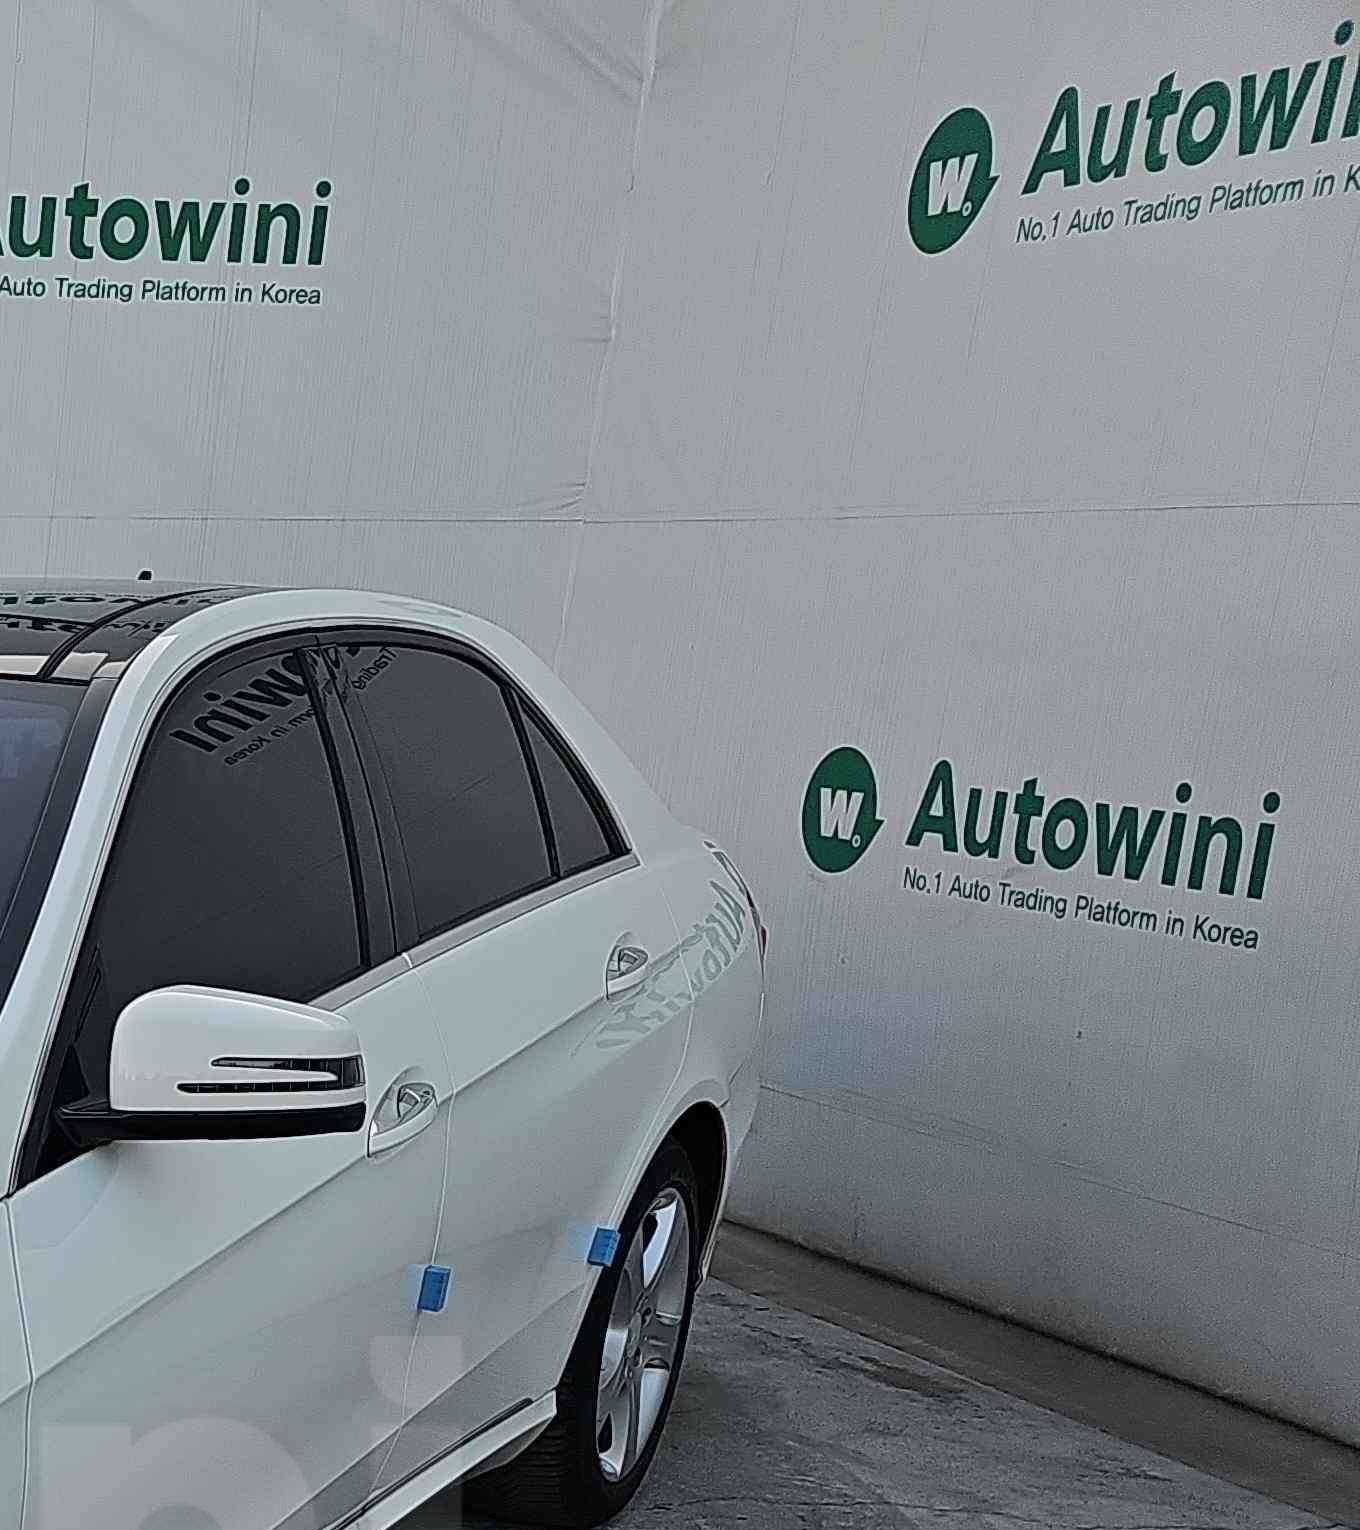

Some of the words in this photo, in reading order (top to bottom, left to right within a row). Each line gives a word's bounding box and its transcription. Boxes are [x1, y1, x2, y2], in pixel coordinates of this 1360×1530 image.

[1016, 211, 1061, 243] No.1
[1065, 207, 1114, 236] Auto
[1124, 194, 1202, 226] Trading
[1208, 178, 1305, 213] Platform
[1312, 169, 1335, 197] in
[54, 277, 133, 303] Trading
[141, 279, 226, 302] Platform
[234, 282, 253, 303] in
[260, 283, 321, 305] Korea
[905, 759, 1281, 900] Autowini
[903, 866, 942, 894] No.1
[948, 875, 991, 903] Auto
[998, 882, 1068, 919] Trading
[1074, 894, 1158, 932] Platform
[1165, 911, 1185, 937] in
[1192, 914, 1259, 950] Korea
